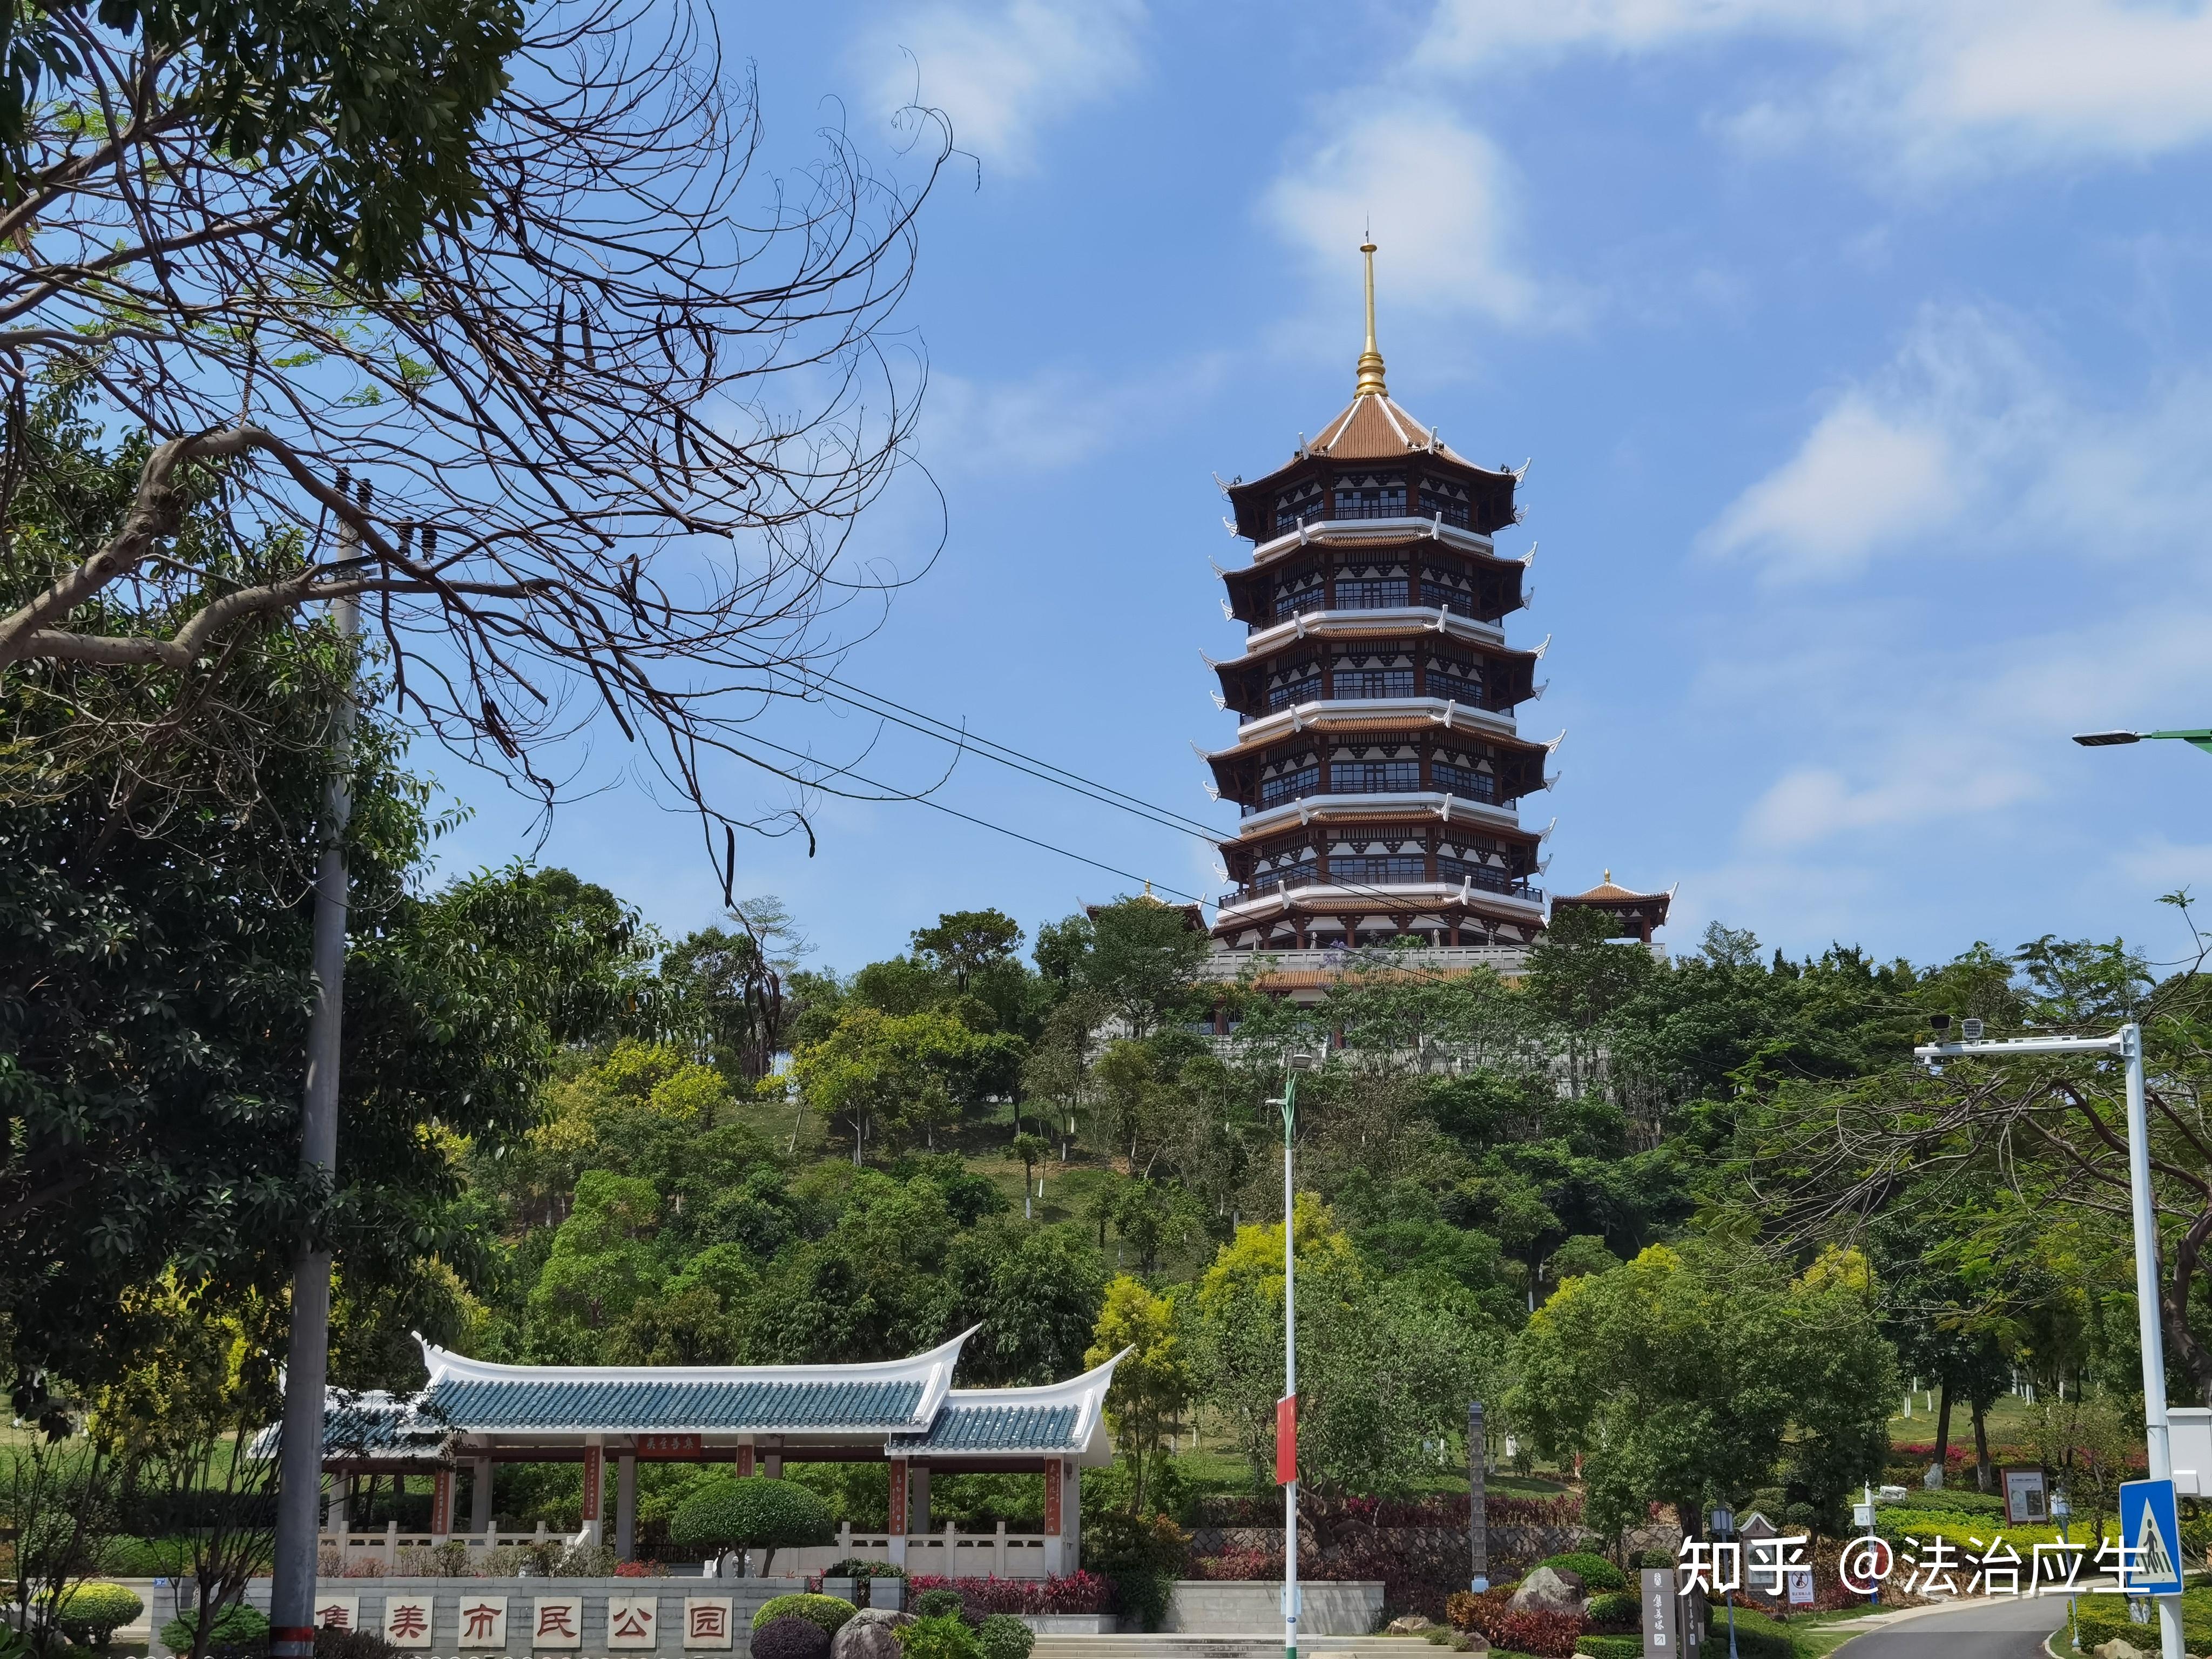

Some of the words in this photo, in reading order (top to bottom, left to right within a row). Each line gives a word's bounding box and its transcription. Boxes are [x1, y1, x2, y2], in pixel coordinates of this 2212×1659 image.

[315, 1604, 727, 1640] 集美市民公园
[1653, 1594, 1664, 1630] 集美塔
